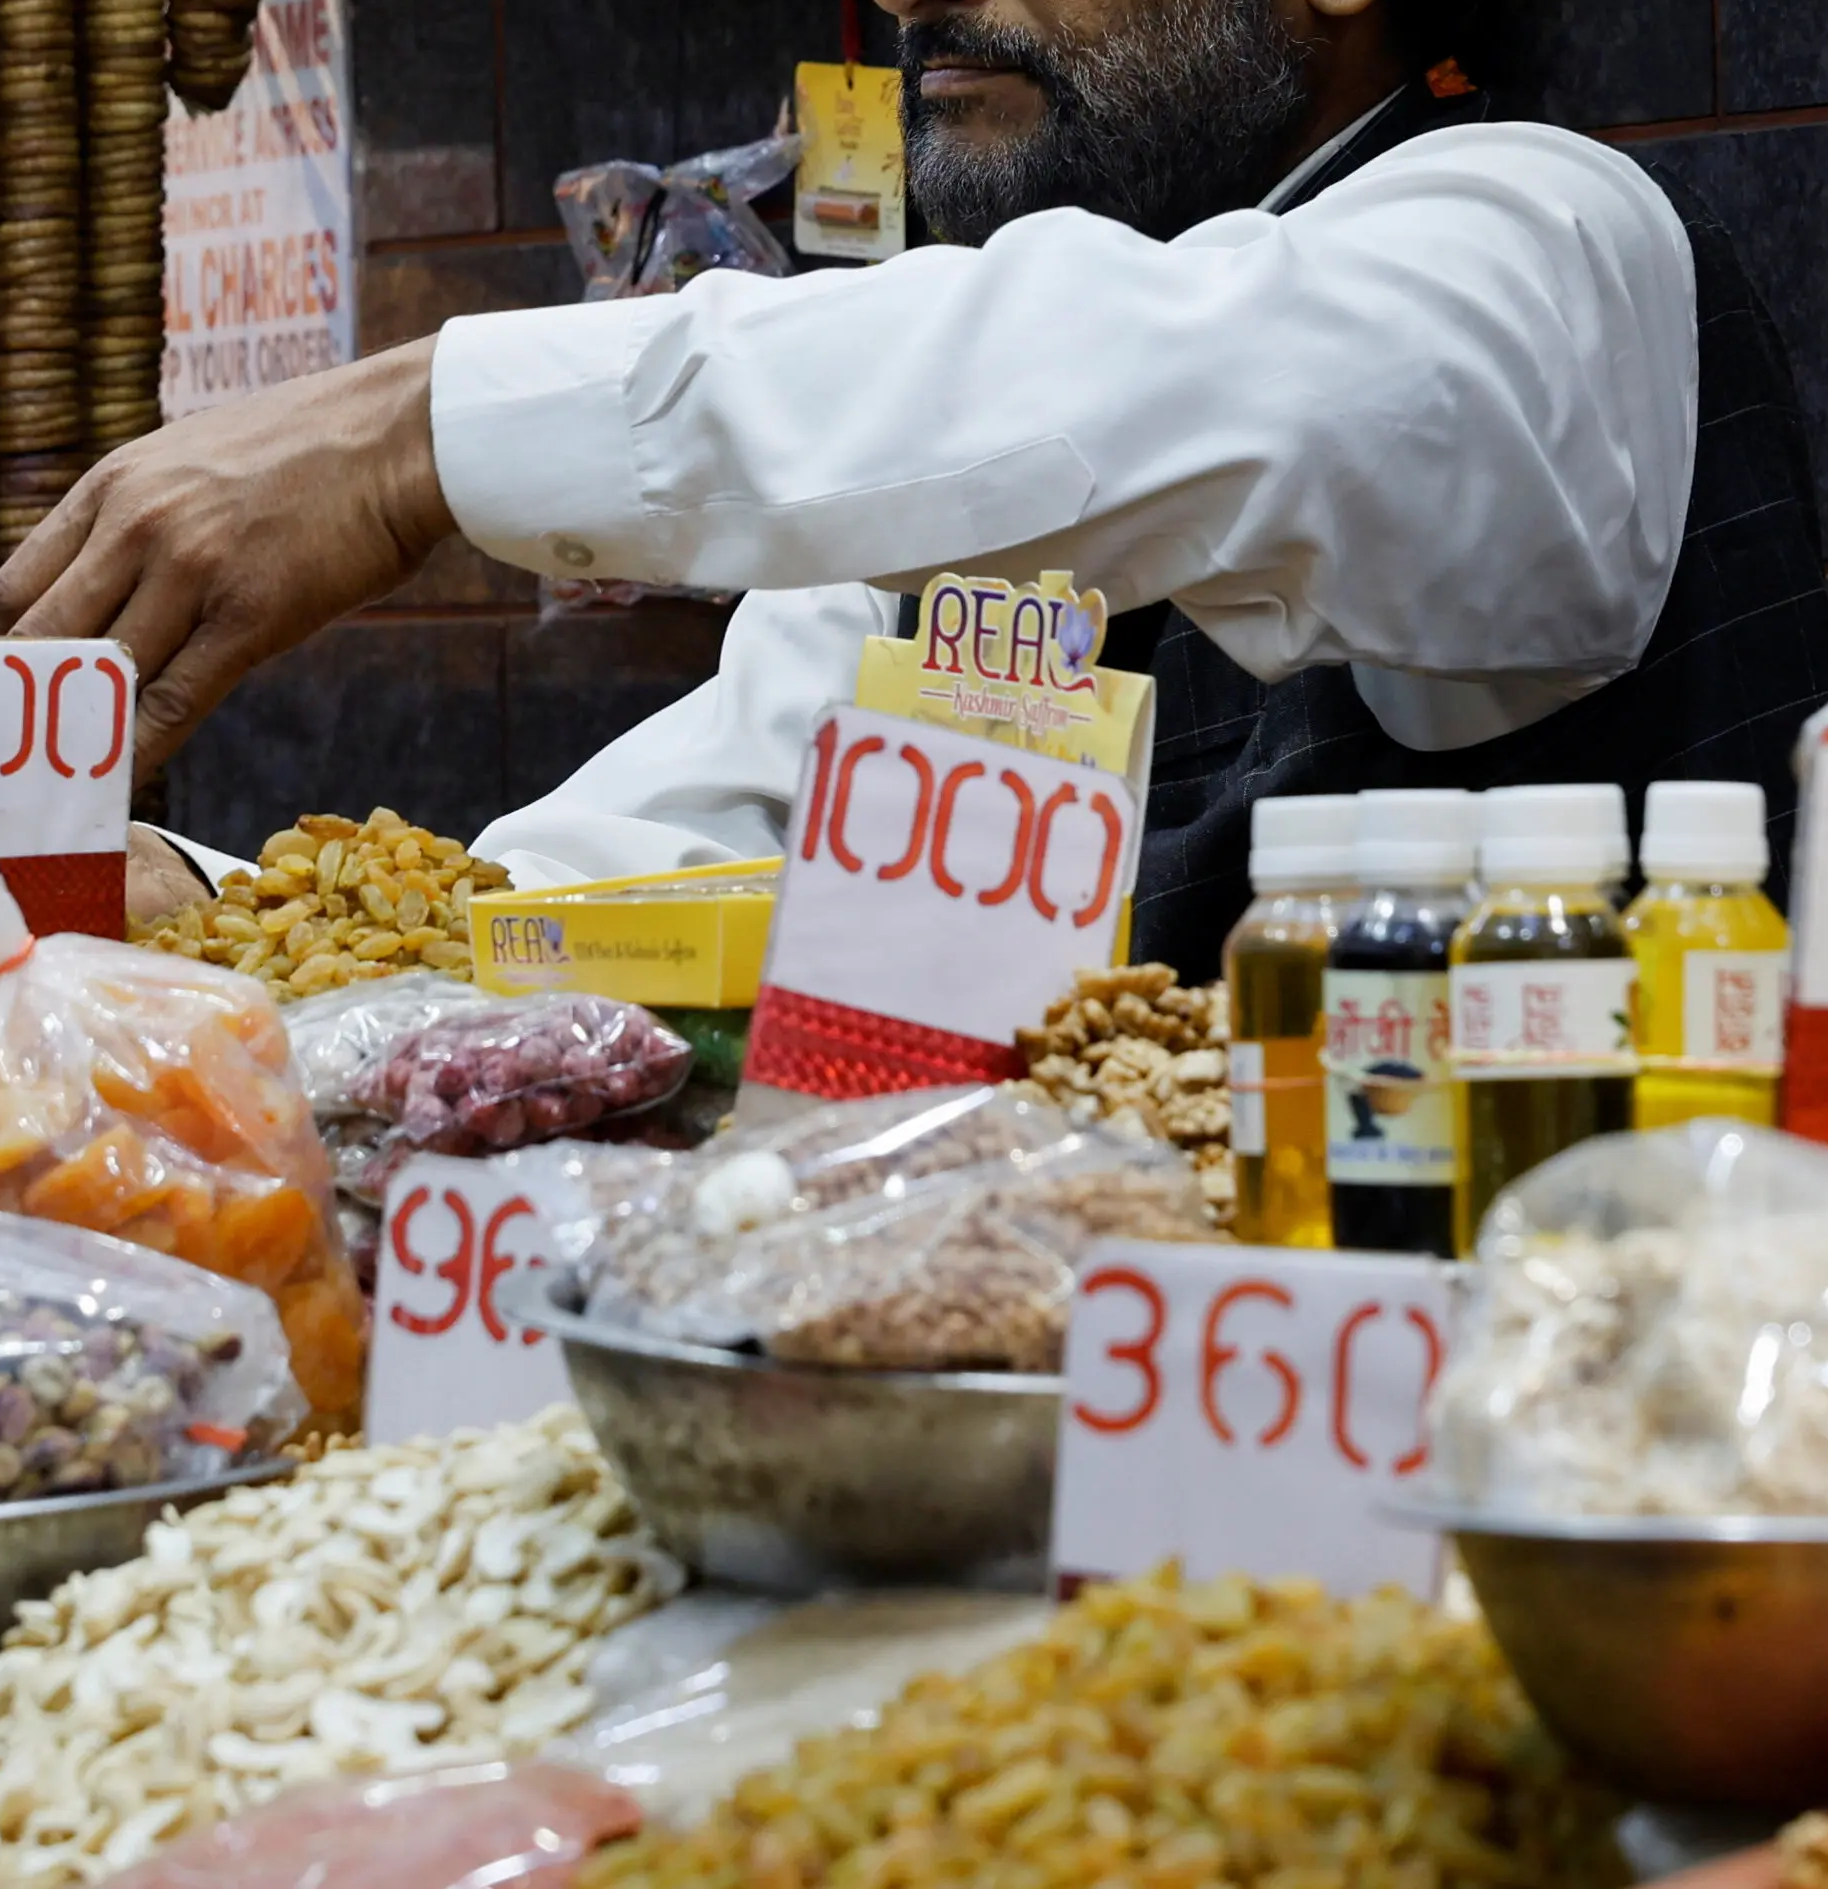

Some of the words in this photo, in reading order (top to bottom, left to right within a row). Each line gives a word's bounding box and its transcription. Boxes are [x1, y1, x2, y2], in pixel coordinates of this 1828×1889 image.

[201, 226, 338, 330] CHARGES
[189, 343, 254, 394] YOUR
[921, 585, 1095, 694] REAL
[952, 682, 1017, 720] Kashmir
[801, 716, 1125, 930] 1000
[490, 916, 571, 964] REAL
[1074, 1265, 1445, 1477] 360
